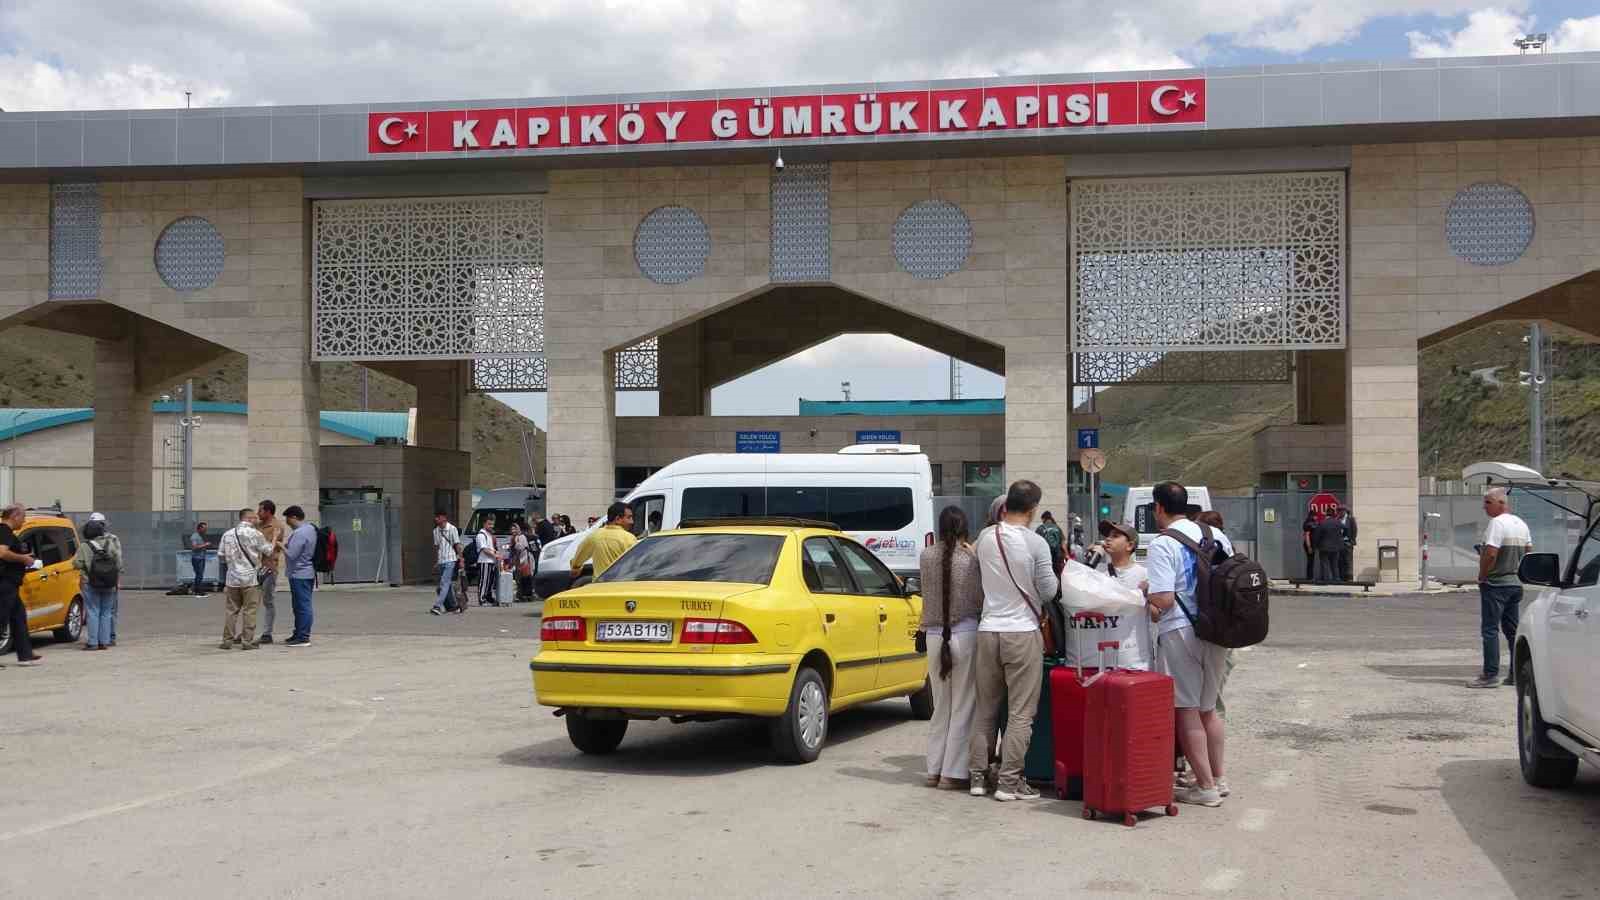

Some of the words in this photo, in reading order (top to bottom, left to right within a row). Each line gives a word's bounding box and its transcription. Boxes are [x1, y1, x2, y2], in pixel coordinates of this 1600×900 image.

[452, 104, 686, 149] KAPIKÖY
[711, 94, 920, 138] GÜMRÜK
[938, 93, 1110, 130] KAPISI
[1083, 435, 1091, 448] 1
[559, 599, 581, 609] IRAN
[680, 599, 712, 611] TURKEY
[607, 623, 668, 637] 53AB119
